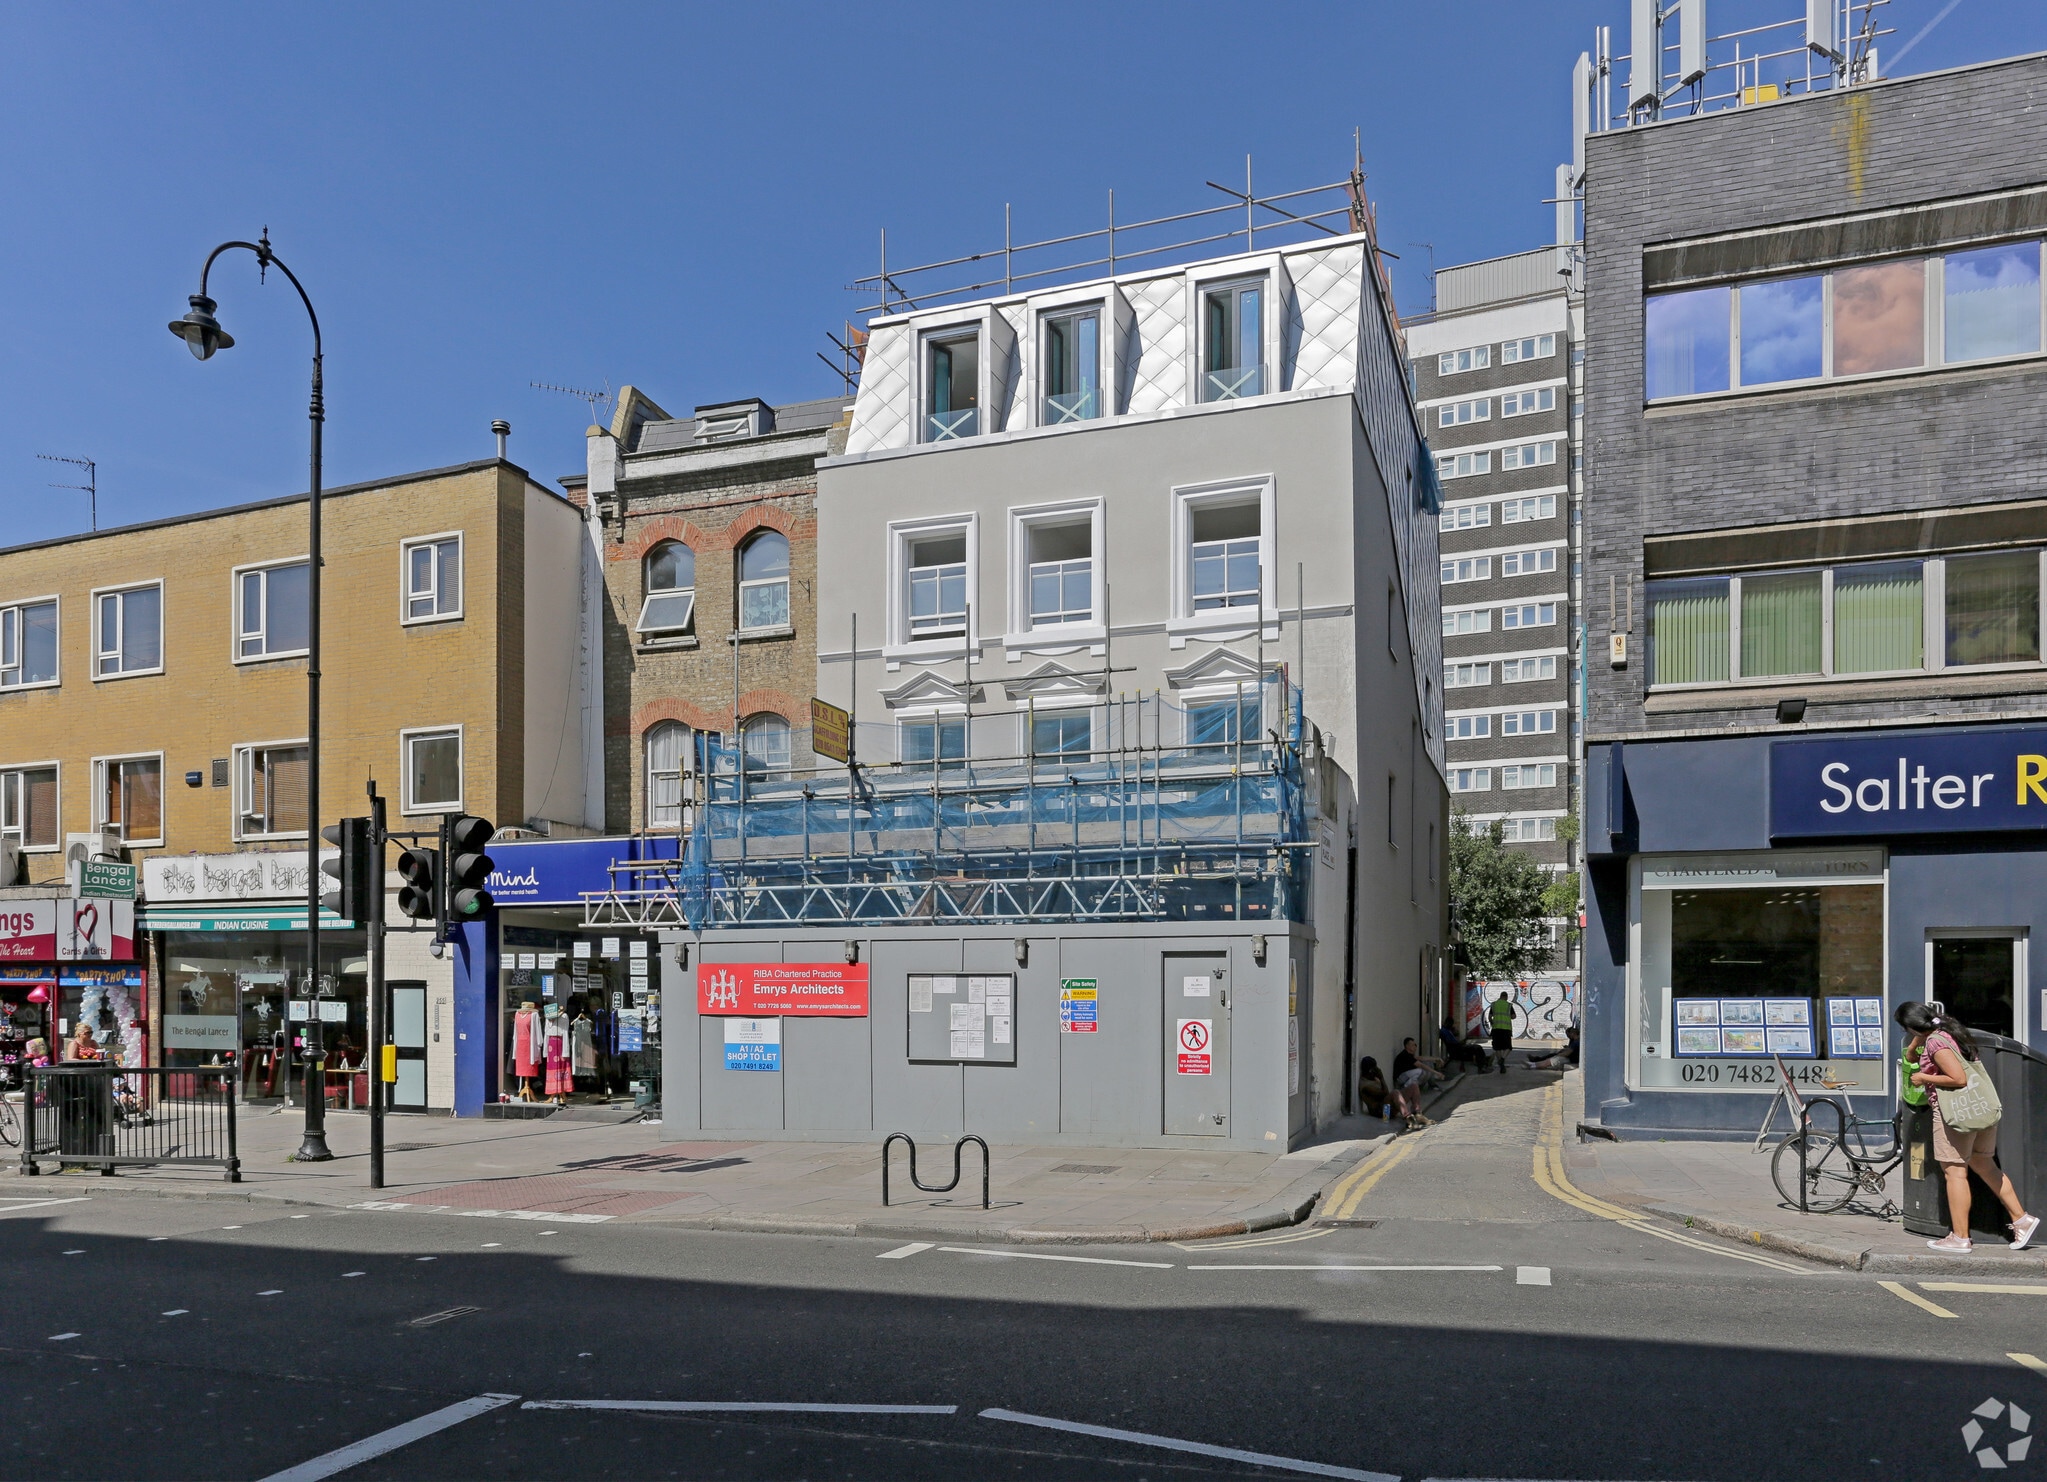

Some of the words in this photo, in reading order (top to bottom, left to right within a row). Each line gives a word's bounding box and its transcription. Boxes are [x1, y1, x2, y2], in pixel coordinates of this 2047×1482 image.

[1820, 758, 1994, 813] Salter
[2017, 754, 2047, 805] R
[86, 863, 129, 876] Bengal
[85, 874, 131, 886] Lancer
[490, 866, 539, 886] mind
[214, 922, 239, 930] INDIAN
[241, 921, 268, 929] CUISINE
[12, 944, 35, 955] Heart
[84, 947, 88, 955] &
[91, 947, 107, 955] Gifts
[80, 970, 102, 983] PARTY
[105, 969, 126, 983] SHOP
[754, 970, 772, 978] RIBA
[774, 970, 810, 978] Chartered
[813, 970, 842, 978] Practice
[754, 984, 787, 996] Emrys
[790, 984, 844, 995] Architects
[172, 1027, 183, 1035] The
[185, 1027, 206, 1037] Bengal
[208, 1028, 228, 1036] Lancer
[1682, 1064, 1719, 1082] 020
[1726, 1065, 1776, 1083] 7482
[1951, 1090, 1984, 1108] HOLL
[1953, 1101, 1991, 1122] ISTER
